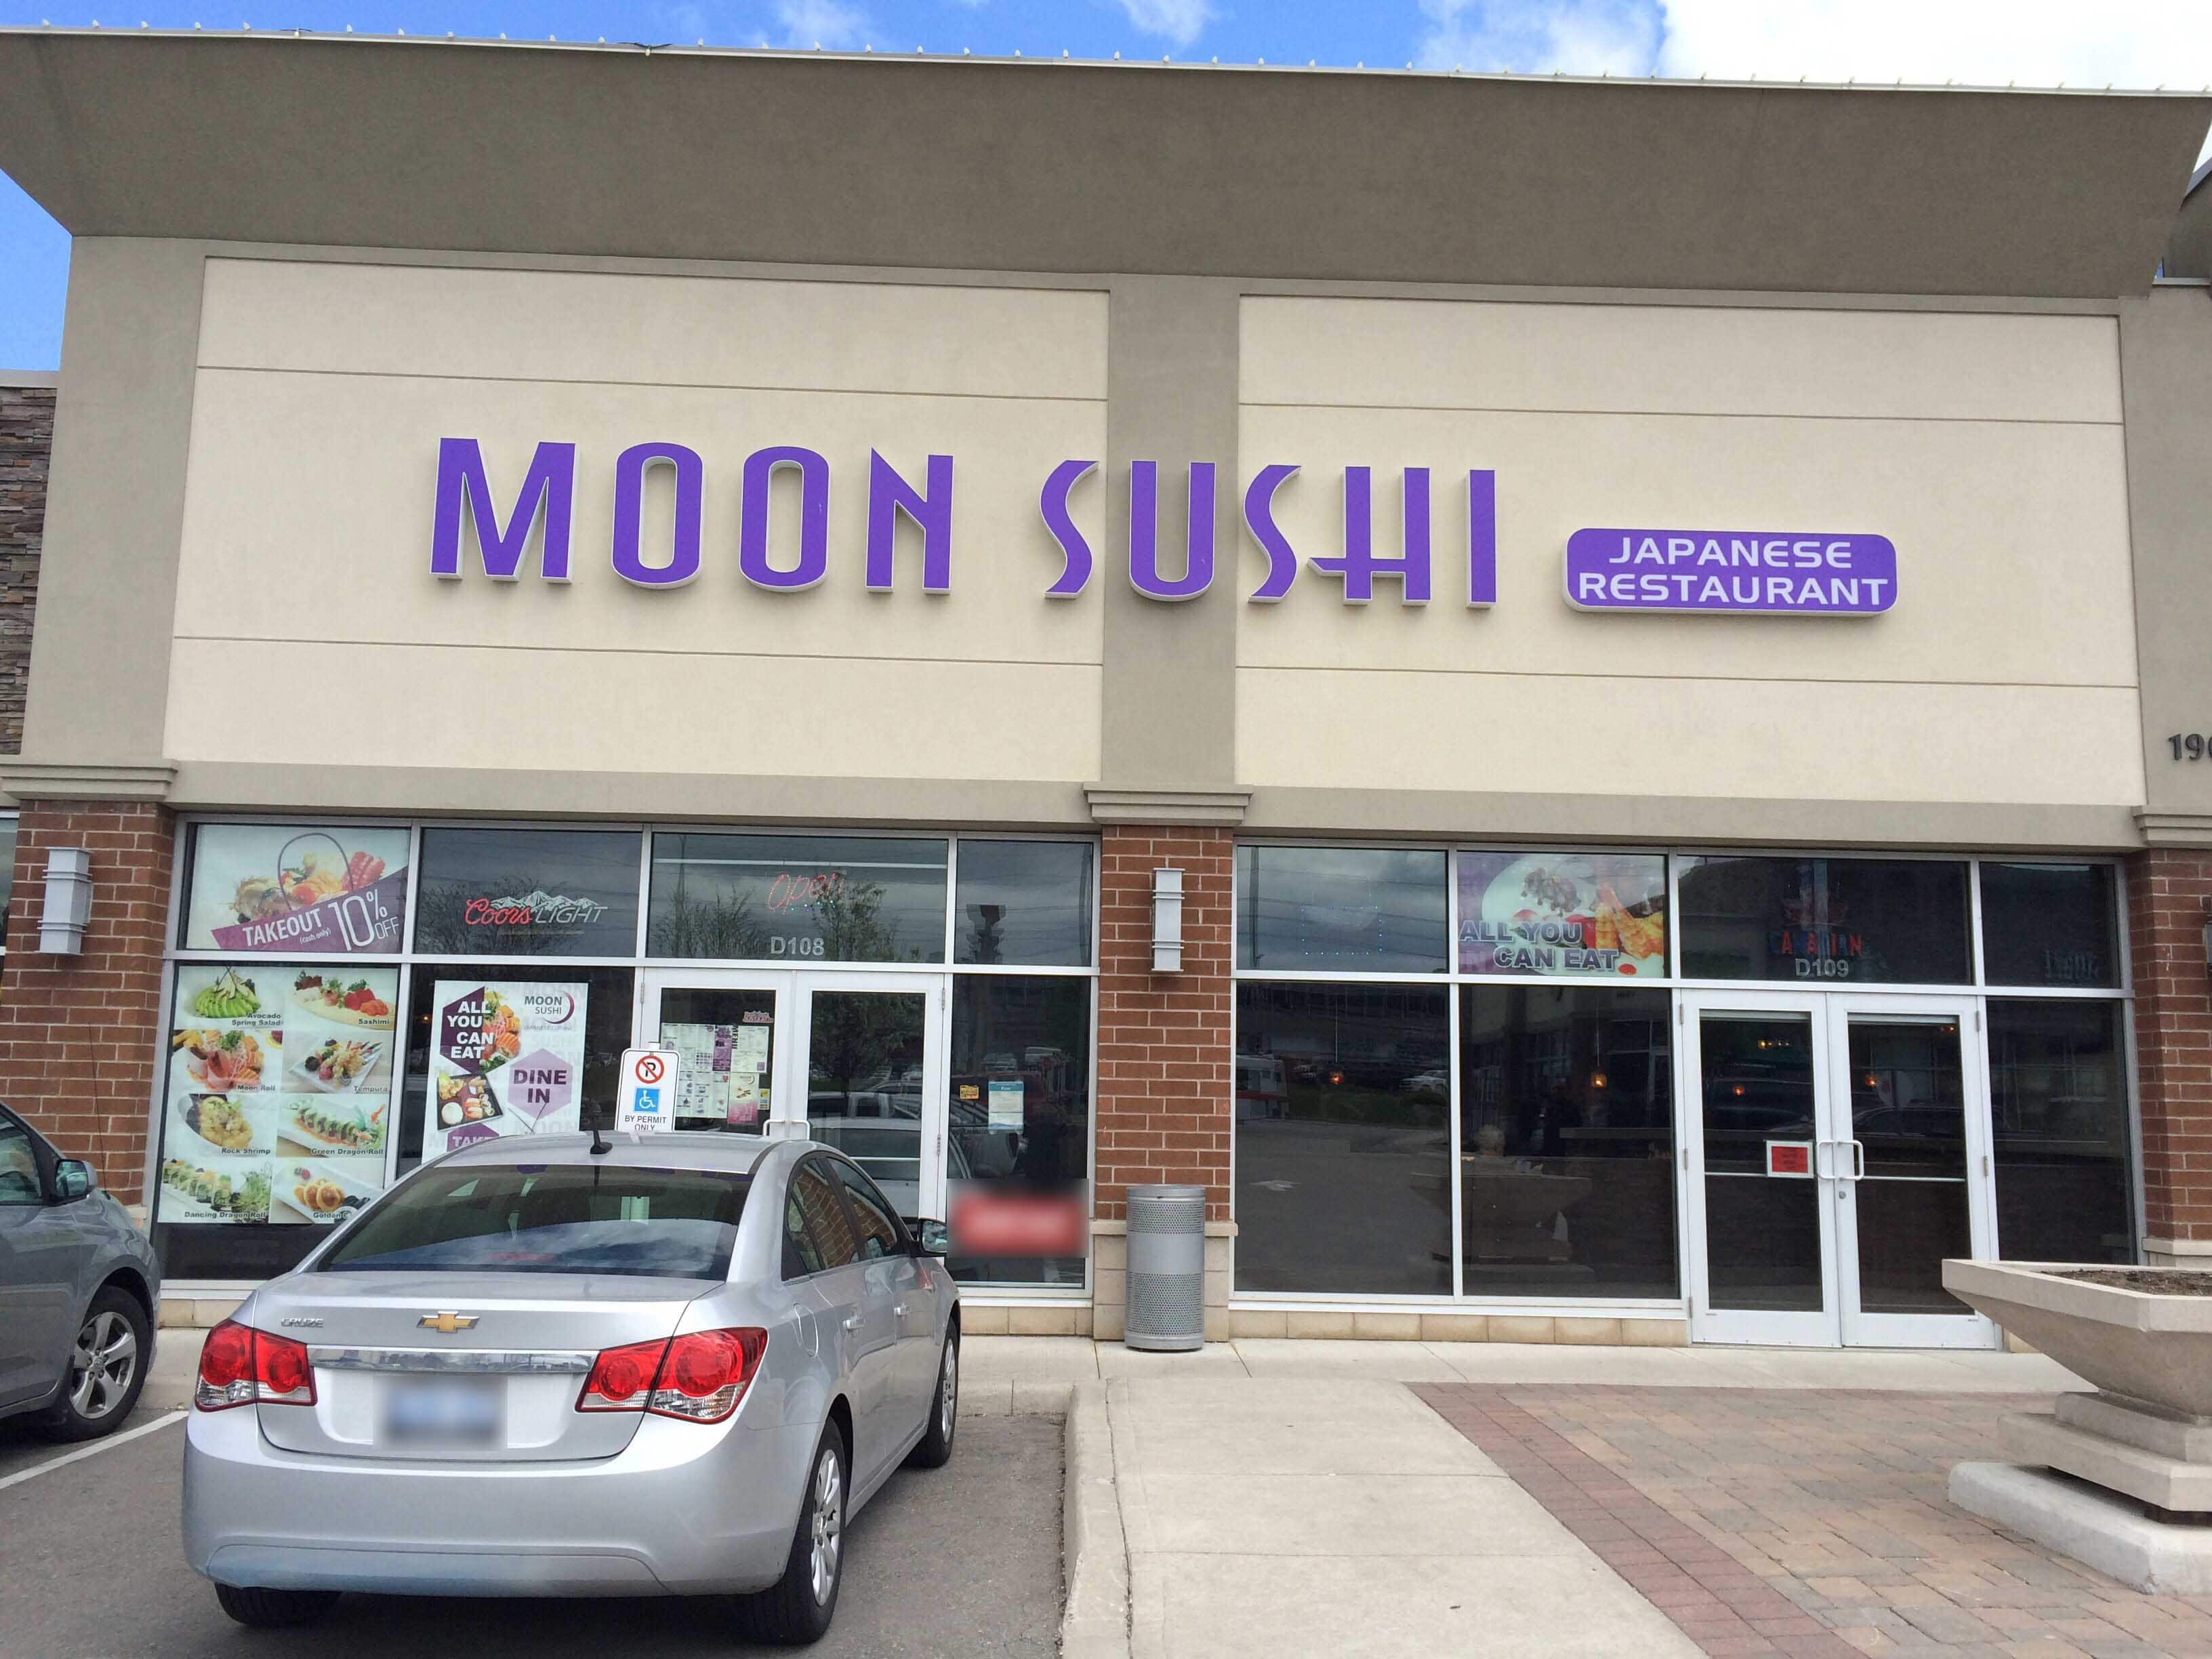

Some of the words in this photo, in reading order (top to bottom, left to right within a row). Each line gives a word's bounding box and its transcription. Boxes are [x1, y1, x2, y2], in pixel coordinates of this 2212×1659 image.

[430, 436, 954, 592] MOON
[1040, 459, 1496, 606] SUSHI
[1609, 537, 1852, 569] JAPANESE
[1579, 572, 1889, 605] RESTAURANT
[465, 897, 533, 926] Coors
[535, 905, 609, 924] LIGHT
[243, 908, 323, 947] TAKEOUT
[328, 888, 388, 951] 10%
[374, 916, 400, 940] OFF
[1458, 920, 1515, 943] ALL
[1524, 920, 1584, 945] YOU
[770, 936, 825, 956] D108
[1493, 945, 1556, 969] CAN
[1563, 948, 1620, 971] EAT
[1795, 958, 1849, 977] D109
[457, 1001, 491, 1013] ALL
[524, 996, 562, 1006] MOON
[535, 1006, 562, 1015] SUSHI
[231, 1019, 256, 1027] Spring
[447, 1015, 483, 1028] YOU
[456, 1031, 495, 1045] CAN
[451, 1046, 486, 1059] EAT
[513, 1069, 568, 1085] DINE
[353, 1086, 388, 1094] Tempura
[527, 1088, 551, 1104] IN
[637, 1115, 668, 1124] PERMIT
[452, 1136, 494, 1147] TAK
[243, 1147, 271, 1156] Shrimp
[337, 1148, 367, 1156] Dragon
[184, 1211, 218, 1219] Dancing
[219, 1211, 250, 1219] Dragon
[281, 1317, 324, 1328] CRUZE
